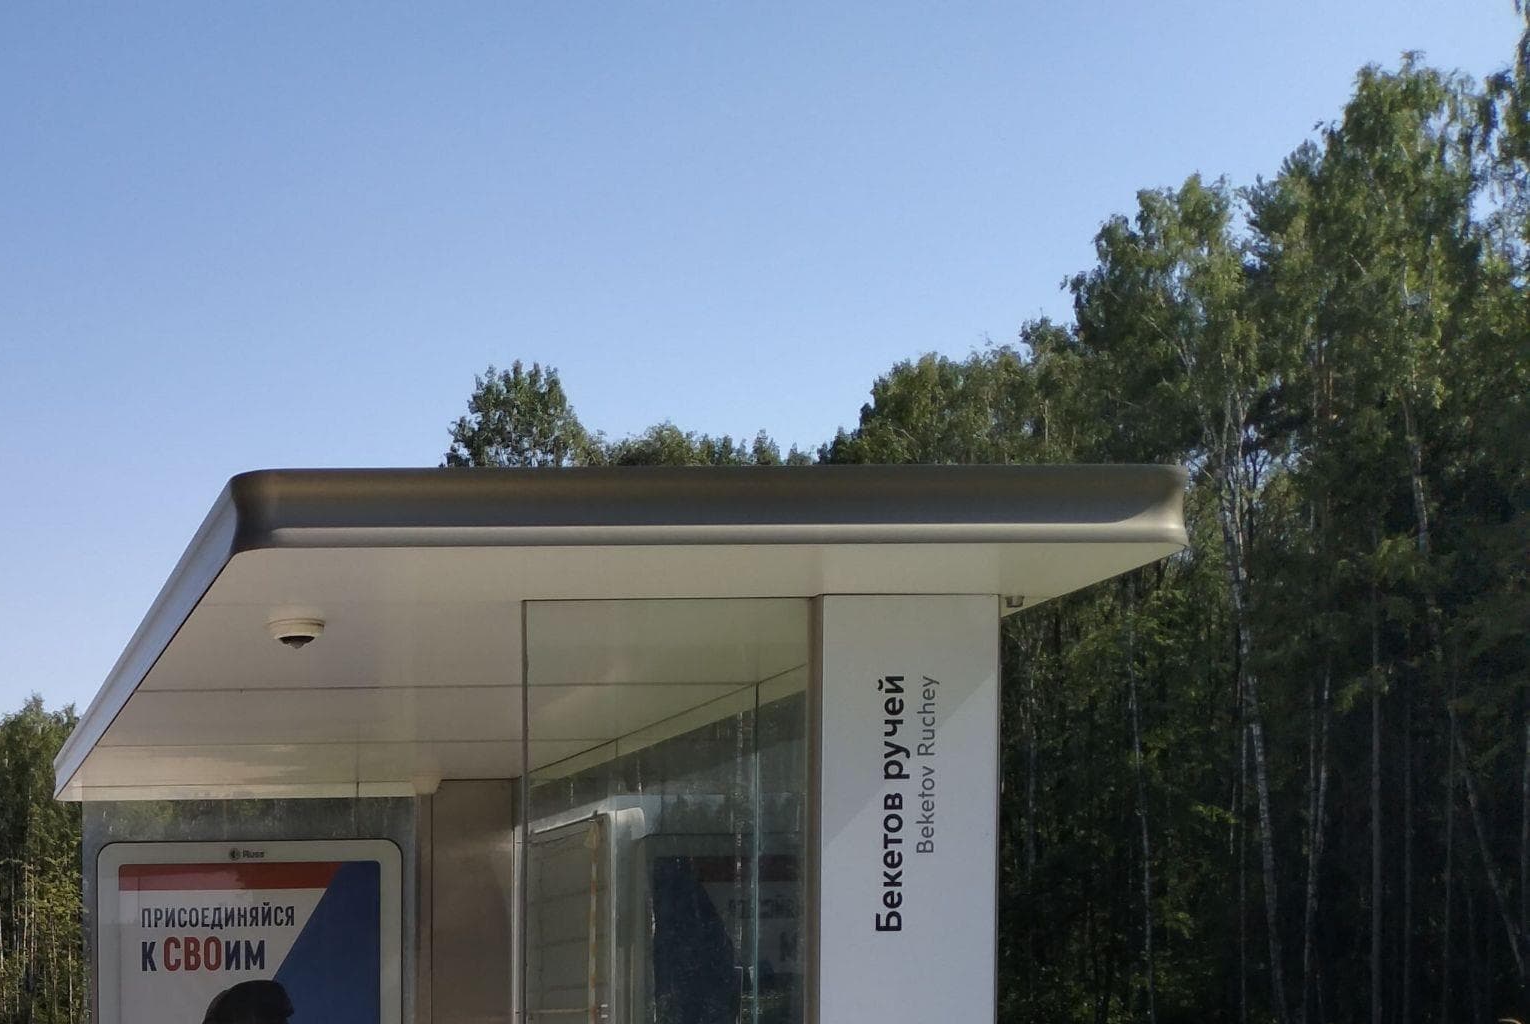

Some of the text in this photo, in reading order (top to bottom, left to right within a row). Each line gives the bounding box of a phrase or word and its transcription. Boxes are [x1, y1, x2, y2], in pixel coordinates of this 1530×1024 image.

[875, 675, 911, 932] Бекетов ручей
[916, 675, 940, 854] Beketov Ruchey
[141, 902, 295, 929] ПРИСОЕДИНЯЙСЯ
[141, 936, 265, 972] К СВОИМ
